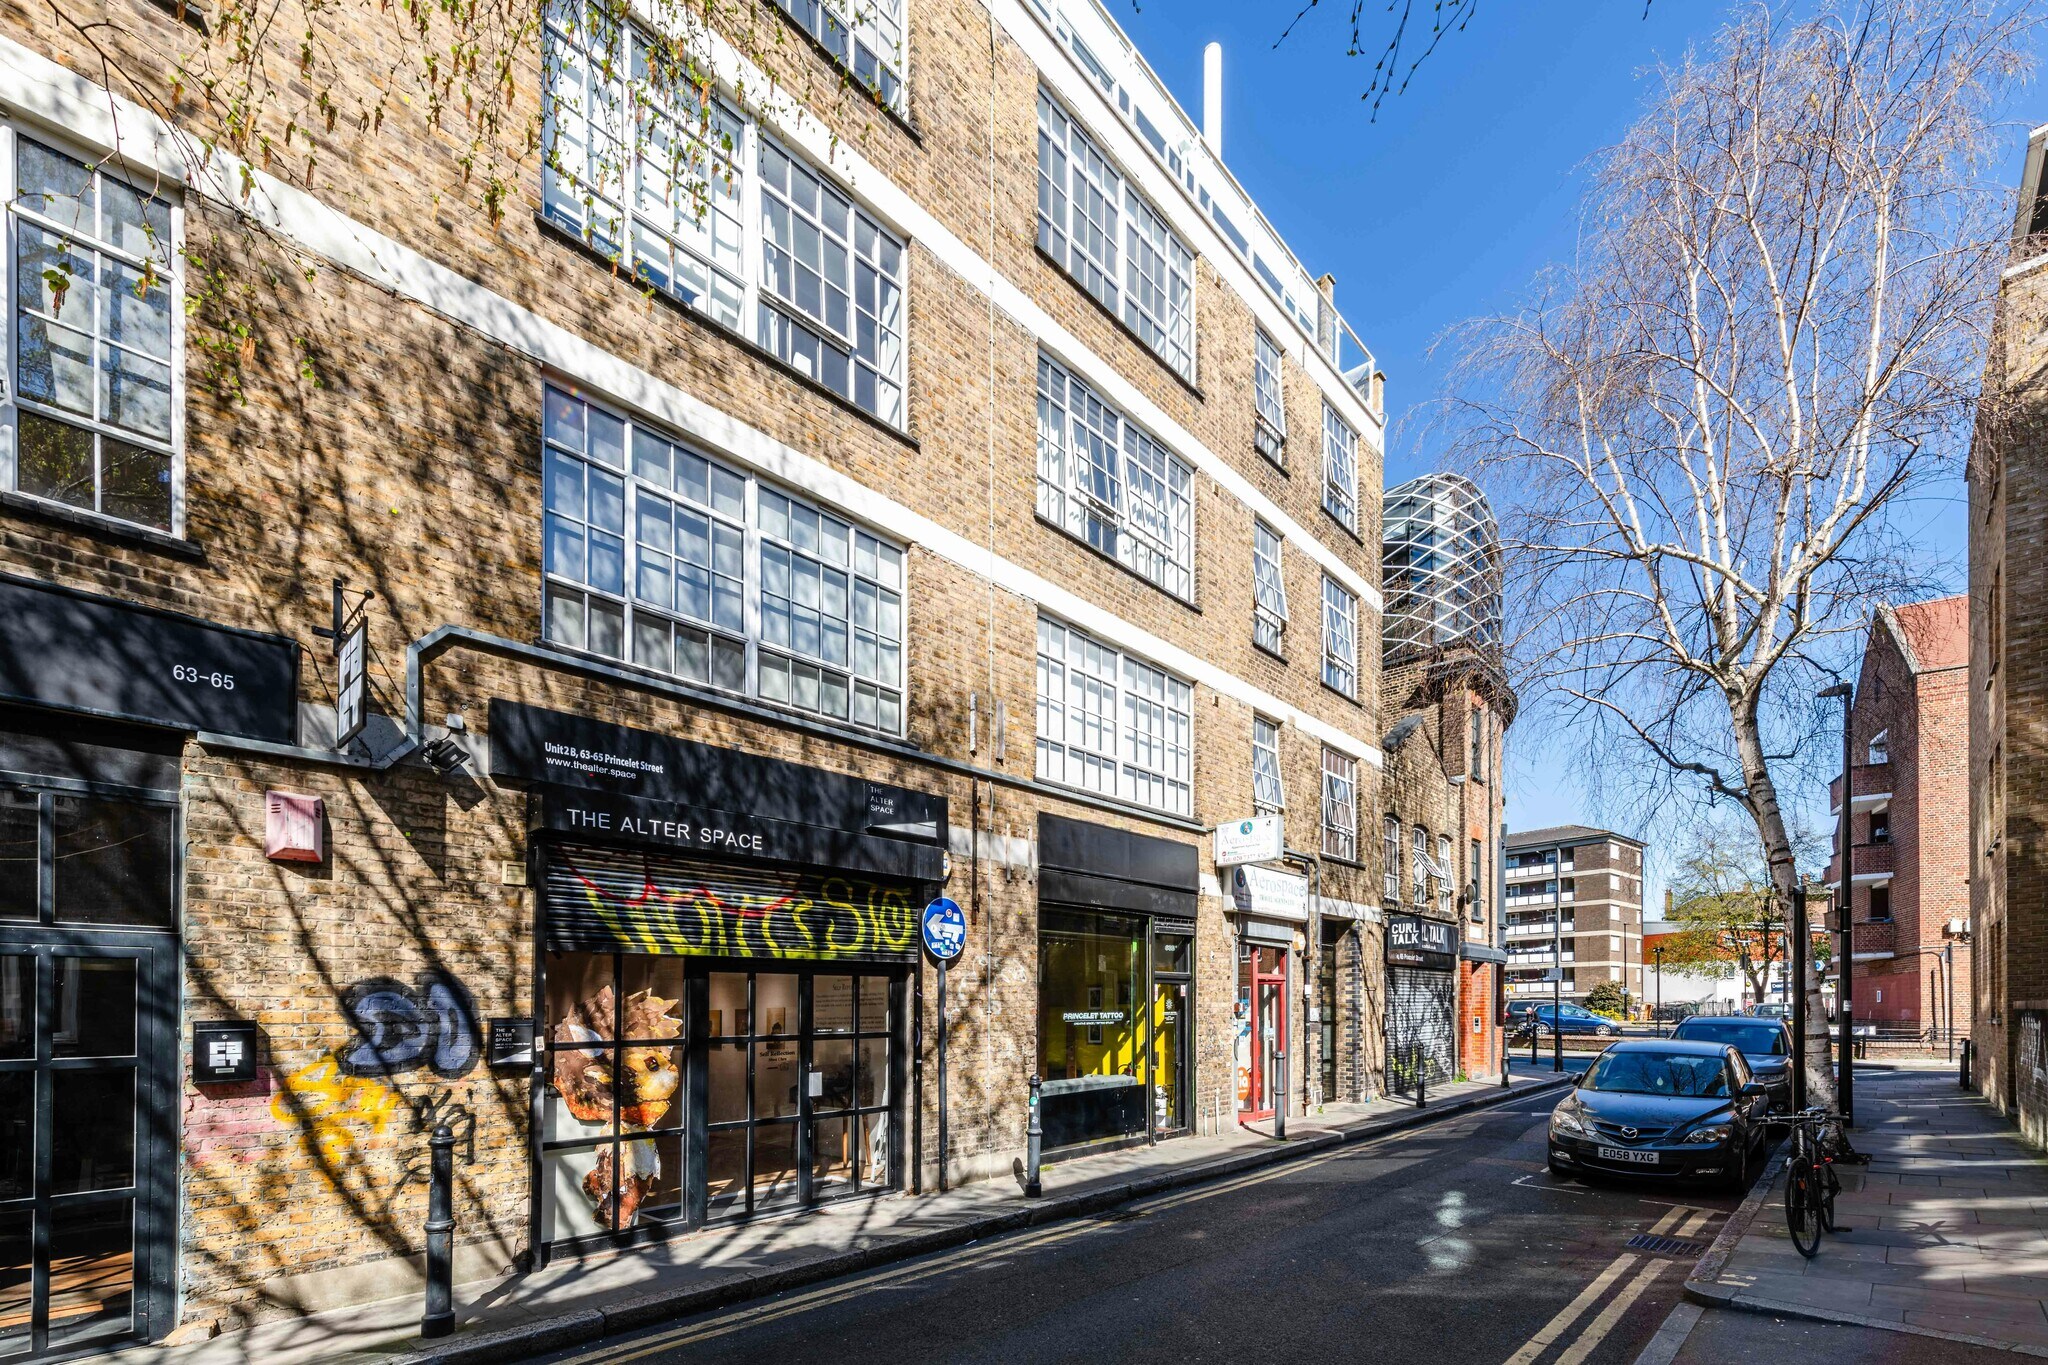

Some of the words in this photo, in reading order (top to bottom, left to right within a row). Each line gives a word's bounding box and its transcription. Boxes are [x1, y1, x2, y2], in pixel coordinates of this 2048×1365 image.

[172, 664, 235, 691] 63-65
[545, 756, 637, 780] www.thealter.space
[579, 749, 604, 762] 63-65
[604, 754, 640, 770] Princelet
[640, 760, 664, 774] Street
[870, 786, 883, 795] THE
[870, 795, 894, 807] ALTER
[870, 804, 895, 816] SPACE
[566, 808, 611, 830] THE
[620, 816, 691, 841] ALTER
[699, 827, 763, 851] SPACE
[1391, 922, 1420, 934] CURL
[1391, 932, 1419, 945] TALK
[1429, 925, 1445, 945] TALK
[1063, 1012, 1099, 1021] PRINCELET
[1099, 1011, 1124, 1020] TATTOO
[1602, 1148, 1630, 1160] EO58
[1632, 1151, 1654, 1162] YXG
